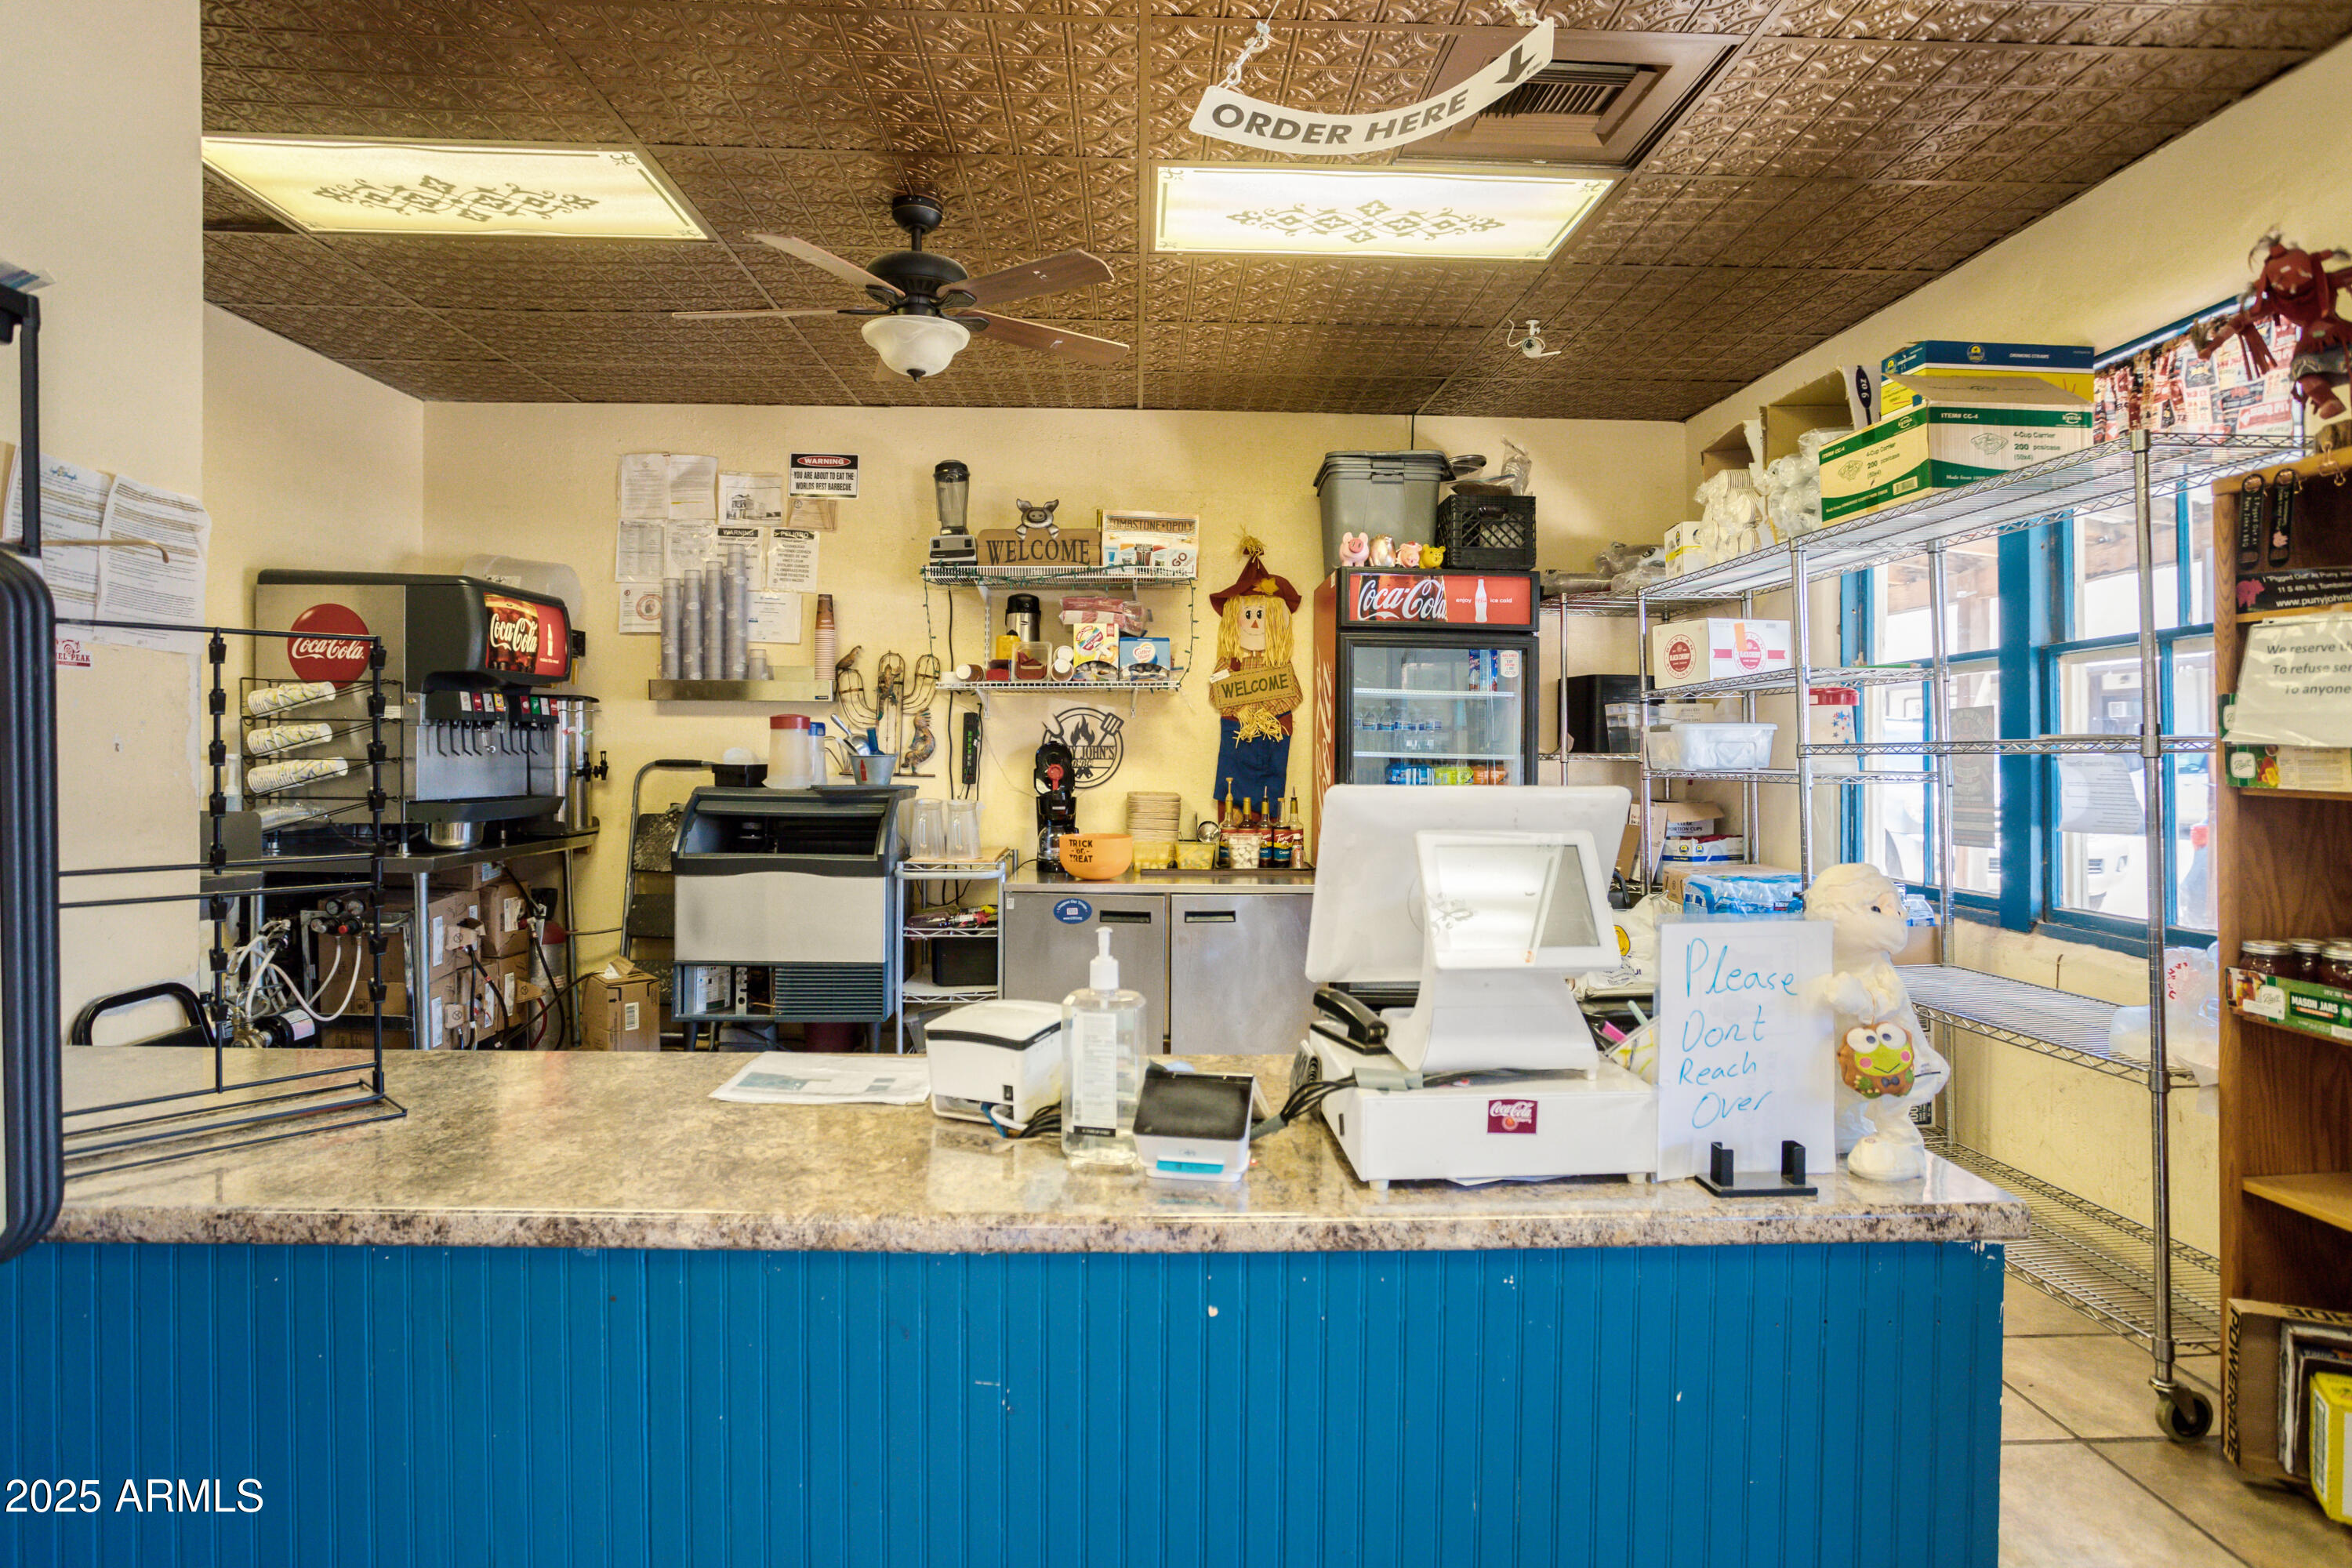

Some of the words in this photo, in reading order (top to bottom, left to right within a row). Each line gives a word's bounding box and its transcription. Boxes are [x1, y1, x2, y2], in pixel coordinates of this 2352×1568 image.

[1211, 103, 1353, 145] ORDER
[1364, 89, 1469, 142] HERE
[1867, 460, 1878, 469] 200
[804, 471, 813, 480] ARE
[814, 471, 829, 480] ABOUT
[845, 472, 854, 481] THE
[985, 539, 1091, 566] WELCOME
[1171, 552, 1188, 567] GO
[1357, 579, 1447, 621] Coca-Cola
[2276, 593, 2352, 608] www.punyjohns
[490, 612, 538, 653] Coca-Cola
[291, 637, 364, 659] Coca-Cola
[1666, 636, 1694, 653] BOYLAN
[2267, 644, 2286, 654] We
[2290, 644, 2336, 654] reserve
[71, 653, 90, 662] PEAK
[2273, 664, 2287, 674] To
[2290, 663, 2331, 674] refuse
[1221, 673, 1289, 699] WELCOME
[2285, 685, 2299, 695] To
[2302, 685, 2351, 698] anyone
[1080, 746, 1115, 760] JOHN'S
[1069, 839, 1093, 848] TRICK
[1069, 854, 1093, 863] TREAT
[1686, 937, 1798, 998] Please
[2291, 995, 2318, 1010] MASON
[2319, 1001, 2339, 1014] JARS
[1682, 1004, 1766, 1053] Dont
[1679, 1051, 1757, 1086] Reach
[1490, 1101, 1535, 1117] Coca-Cola
[1692, 1091, 1773, 1129] Over
[2227, 1306, 2241, 1468] POWERADE
